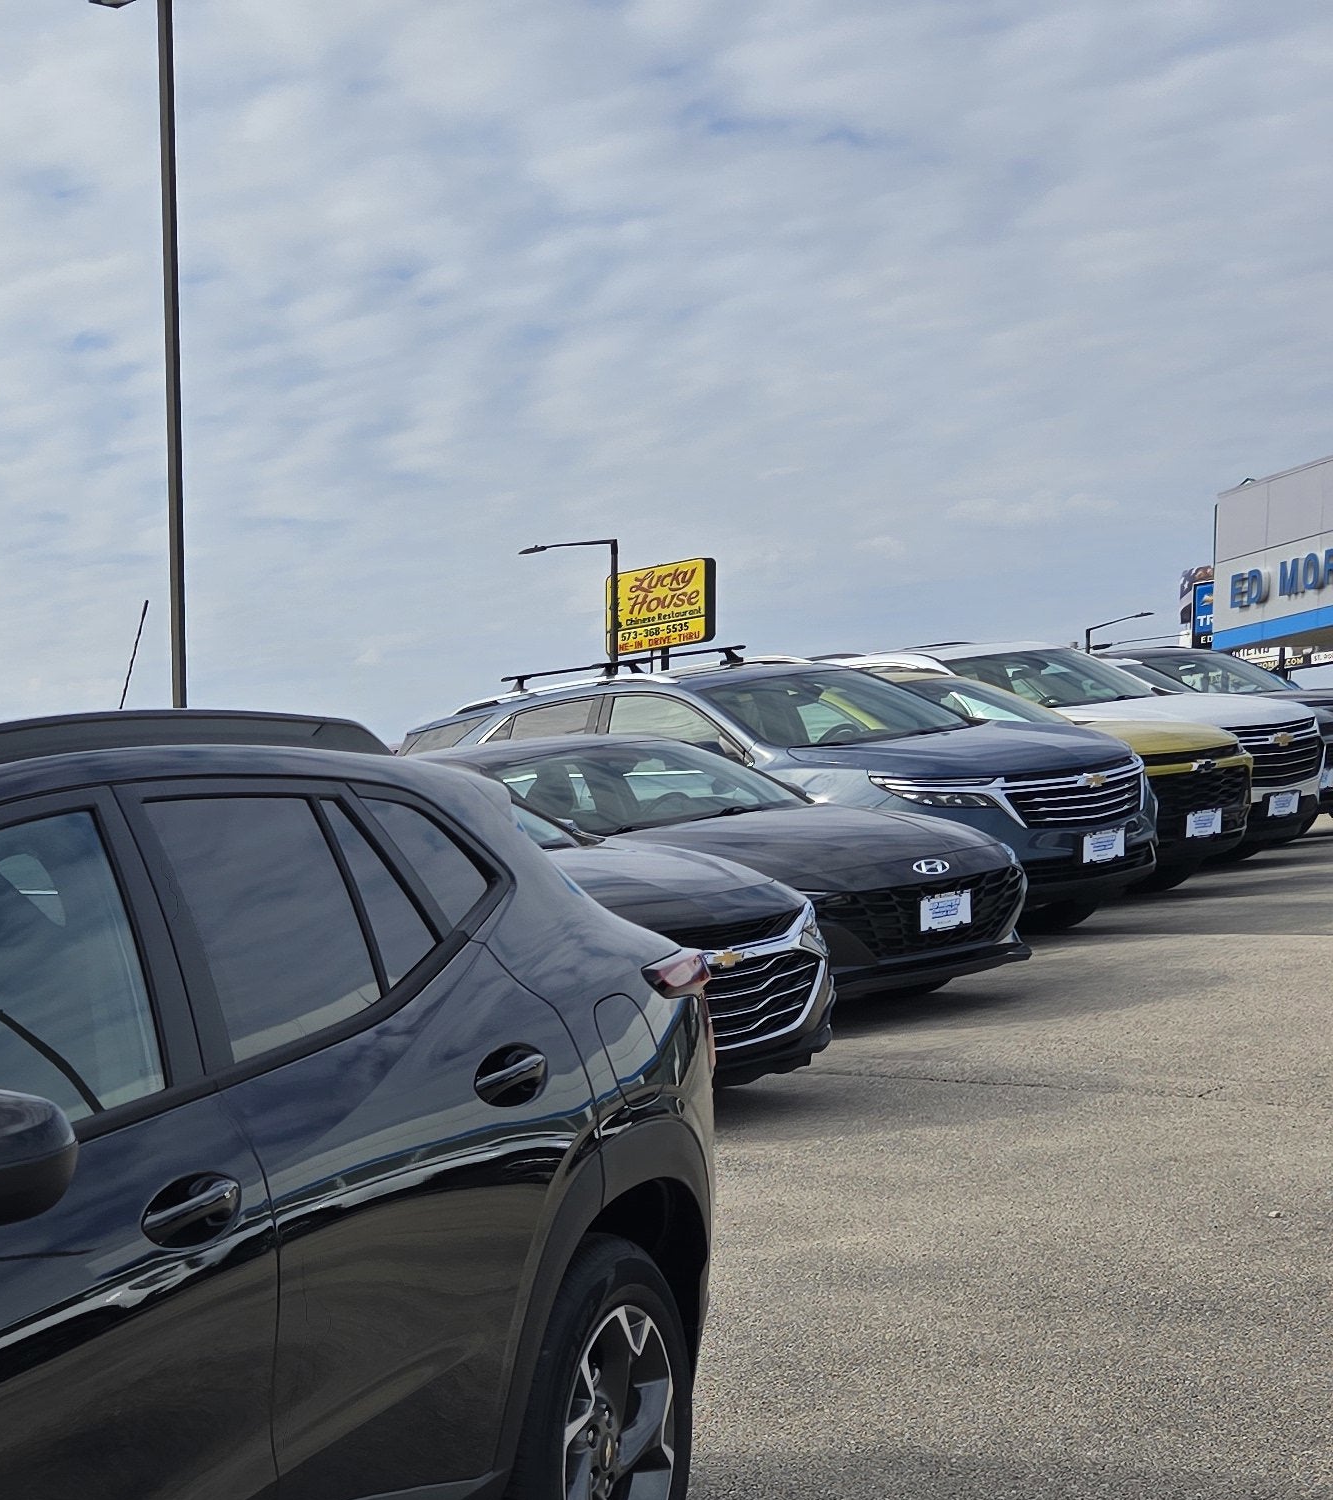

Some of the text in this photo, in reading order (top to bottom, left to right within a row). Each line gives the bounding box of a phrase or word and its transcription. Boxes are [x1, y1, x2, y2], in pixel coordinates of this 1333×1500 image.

[630, 566, 697, 593] Lucky
[1230, 568, 1264, 609] ED
[628, 589, 700, 615] House
[625, 606, 702, 626] Chinese Restaurant
[621, 621, 690, 641] 573-368-5535
[648, 630, 701, 648] DRIVE-THRU
